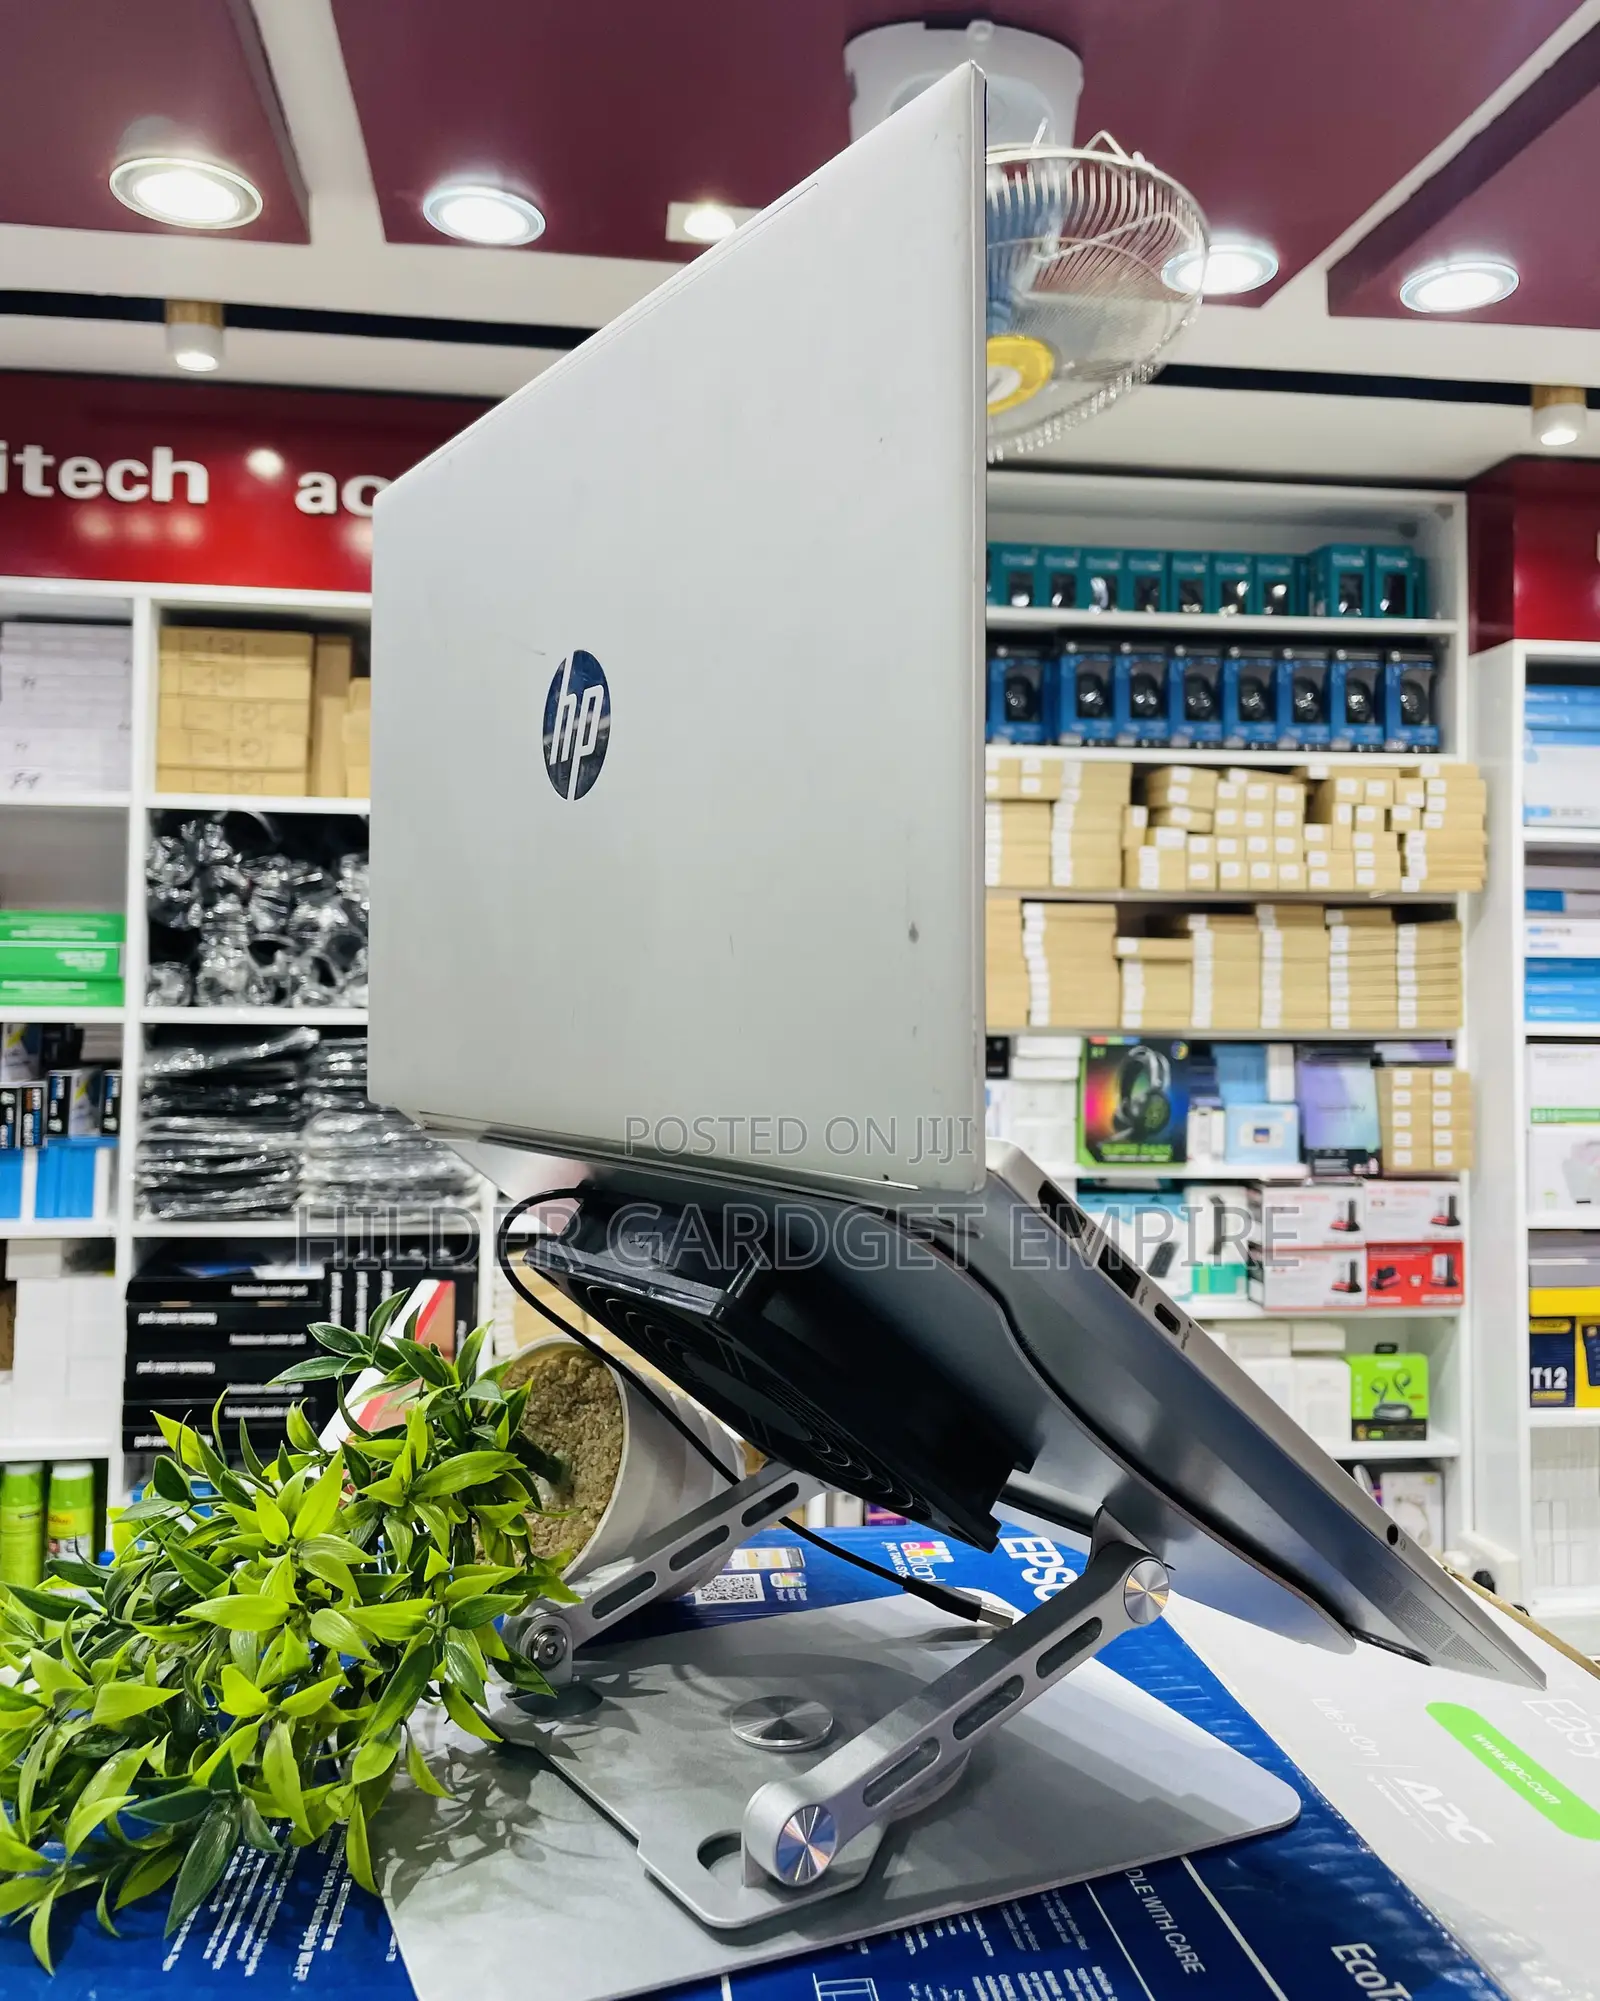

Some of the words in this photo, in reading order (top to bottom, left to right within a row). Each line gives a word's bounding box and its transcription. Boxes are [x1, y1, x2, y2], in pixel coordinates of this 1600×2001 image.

[547, 650, 607, 801] hp
[1310, 1698, 1347, 1722] Life
[1349, 1735, 1380, 1757] On
[1471, 1733, 1561, 1804] www.apc.com
[1392, 1776, 1496, 1846] APC
[1141, 1895, 1178, 1931] WITH
[1165, 1932, 1207, 1974] CARE
[1330, 1942, 1414, 2001] EcoT
